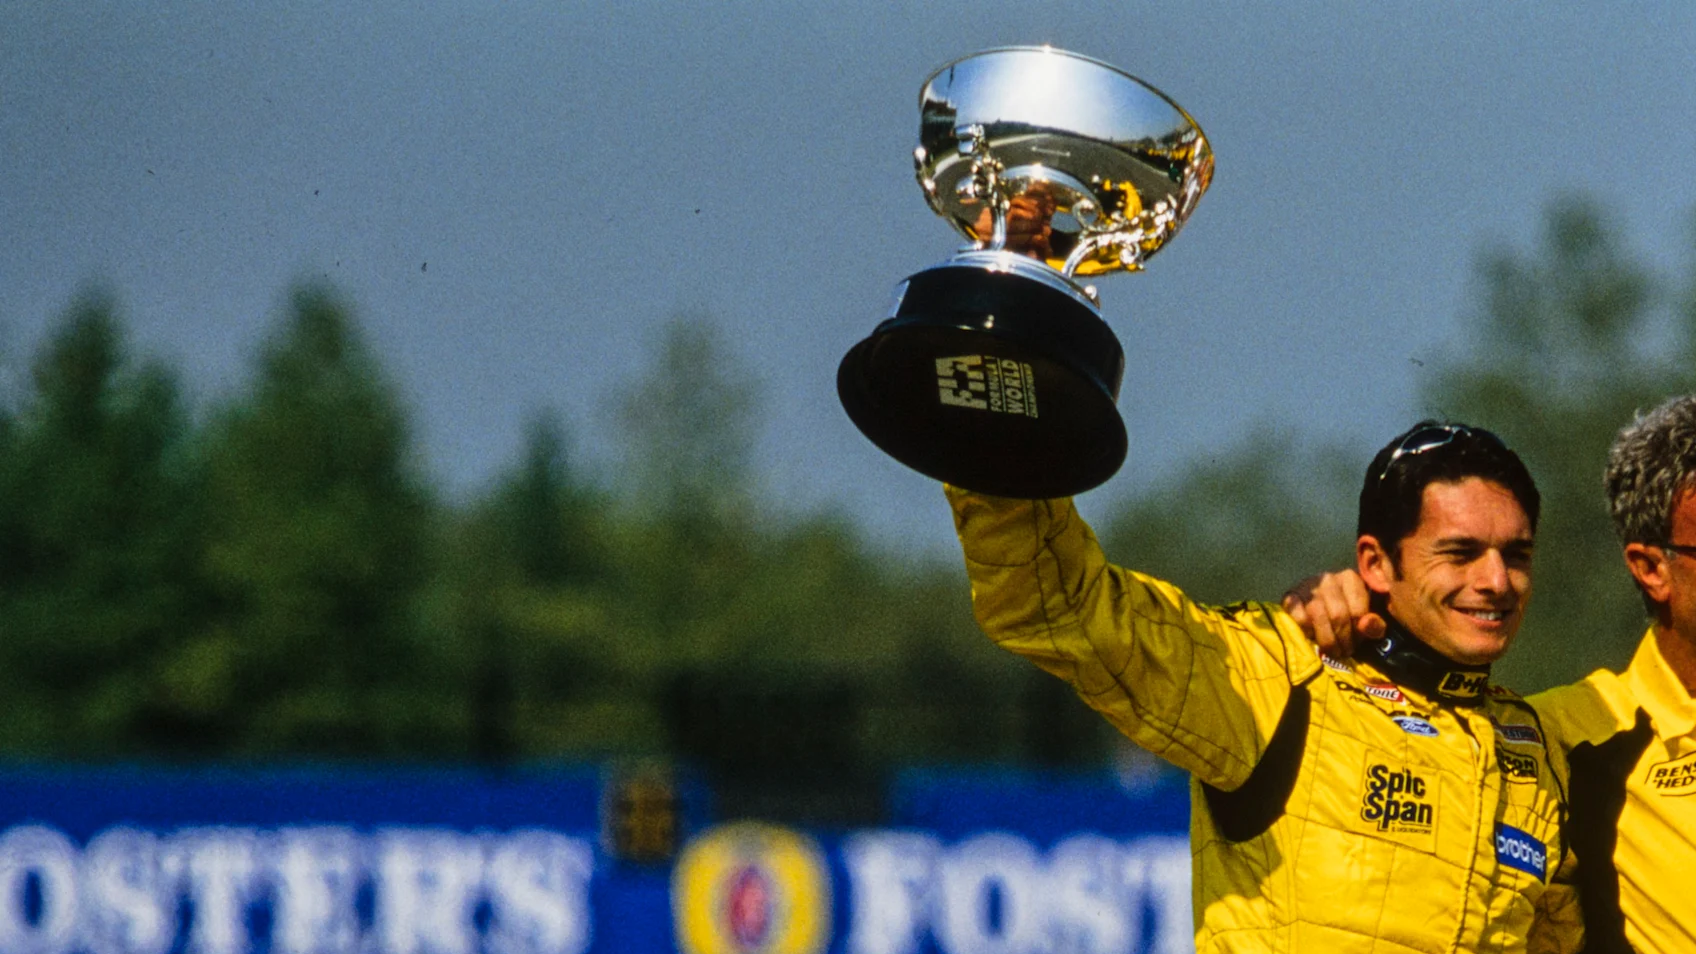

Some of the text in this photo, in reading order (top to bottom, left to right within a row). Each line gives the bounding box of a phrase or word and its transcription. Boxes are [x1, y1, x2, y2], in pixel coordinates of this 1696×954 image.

[1001, 359, 1024, 413] WORLD
[1366, 763, 1427, 800] Spic
[1360, 792, 1434, 832] Span
[1496, 832, 1547, 873] brother
